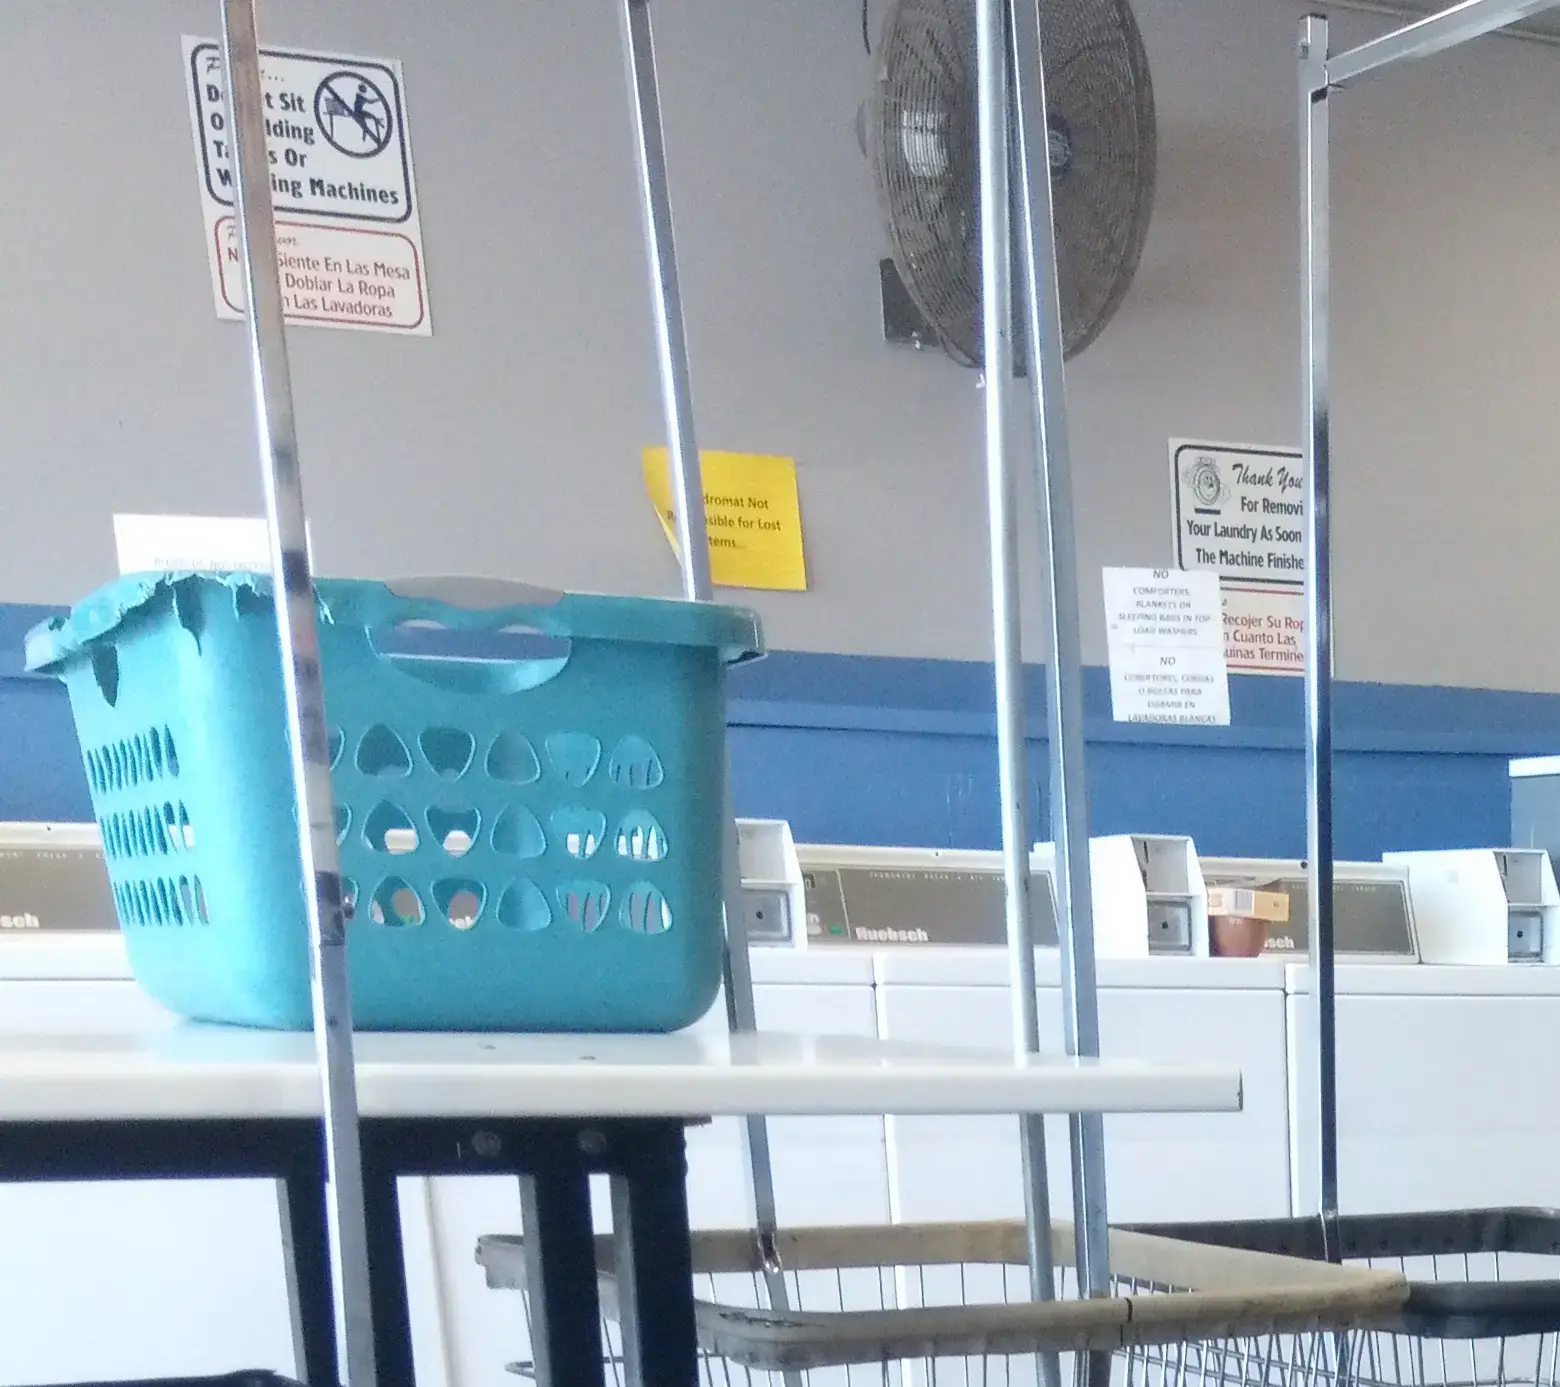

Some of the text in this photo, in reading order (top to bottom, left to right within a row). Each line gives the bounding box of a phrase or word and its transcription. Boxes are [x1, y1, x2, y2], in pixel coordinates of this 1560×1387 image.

[280, 92, 306, 113] Sit
[266, 119, 315, 145] lding
[284, 149, 307, 168] Or
[309, 178, 399, 205] Machines
[325, 256, 342, 273] En
[346, 259, 369, 277] Las
[374, 262, 411, 280] Mesa
[337, 279, 355, 294] La
[358, 281, 395, 300] Ropa
[294, 294, 318, 310] Las
[322, 297, 393, 317] Lavadoras
[1232, 463, 1303, 496] Thank You
[748, 496, 769, 510] Not
[1240, 496, 1304, 516] For Removi
[737, 515, 754, 528] for
[757, 518, 782, 531] Lost
[1187, 520, 1302, 548] Your Laundry As Soon
[1195, 548, 1304, 571] The Machine Finishe
[1153, 569, 1169, 580] NO
[1267, 614, 1282, 628] Su
[1233, 629, 1275, 645] Cuanto
[1277, 631, 1297, 647] Las
[1160, 656, 1176, 666] NO
[1258, 646, 1304, 663] Termine
